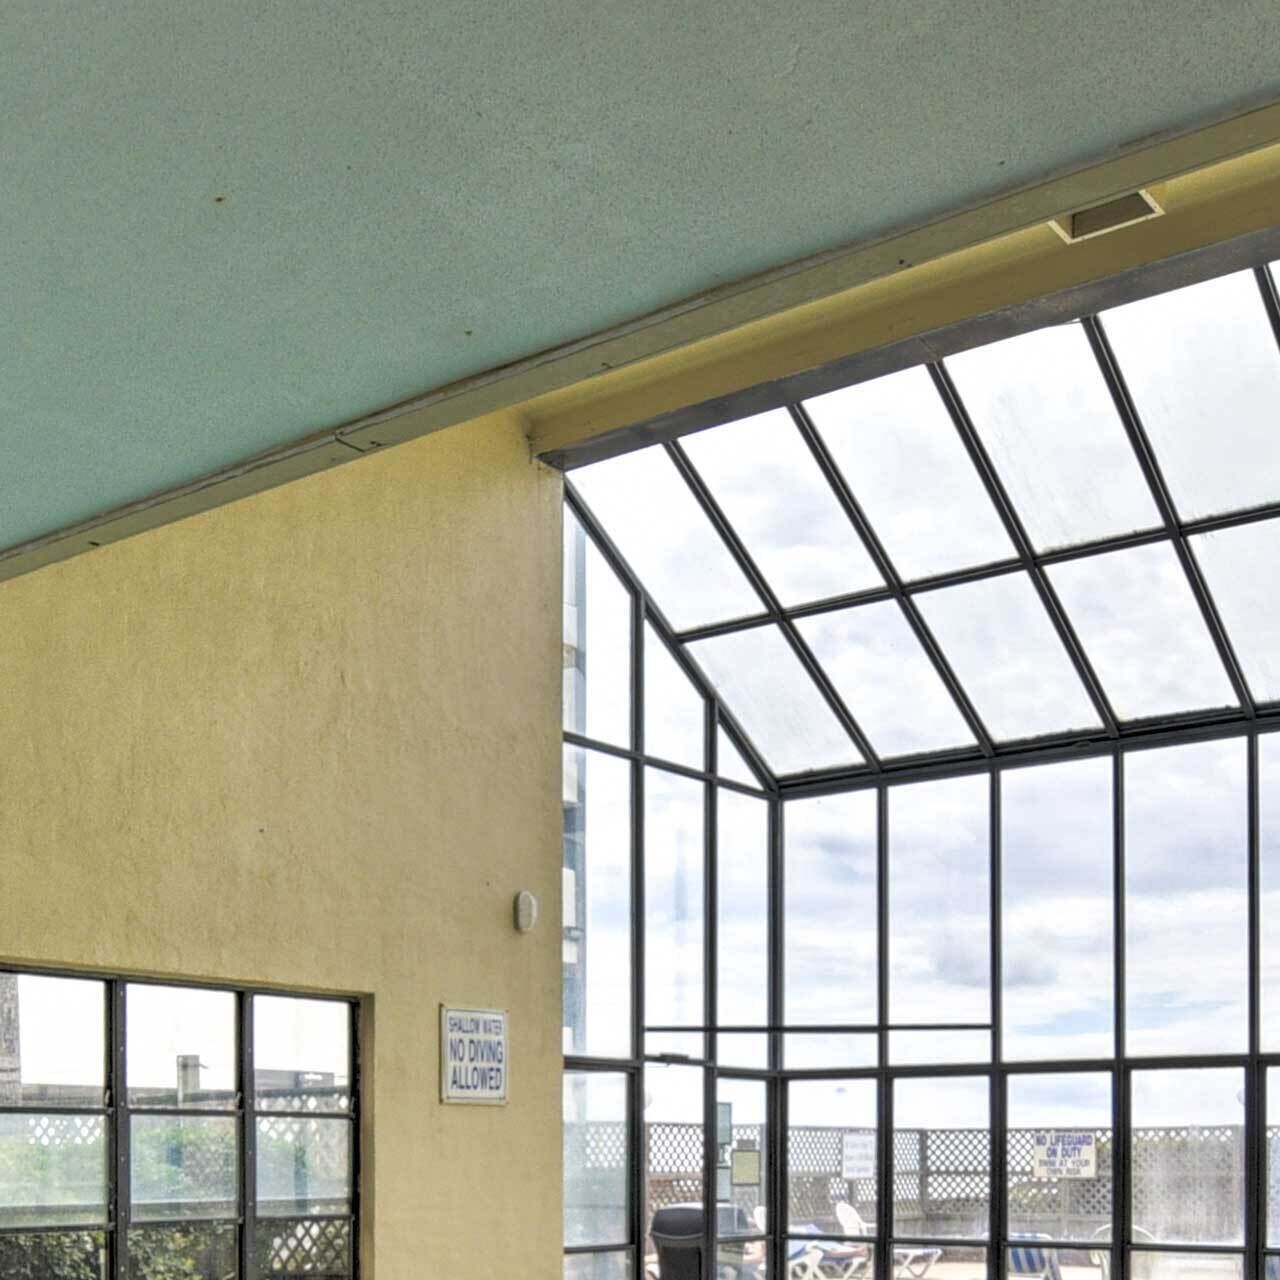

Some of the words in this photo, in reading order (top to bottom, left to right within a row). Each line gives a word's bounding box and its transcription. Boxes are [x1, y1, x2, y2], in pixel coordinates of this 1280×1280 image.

[449, 1038, 465, 1062] NO
[468, 1039, 503, 1064] DIVING
[450, 1066, 502, 1090] ALLOWED
[1035, 1135, 1047, 1146] NO
[1050, 1134, 1093, 1146] LIFEGUARD
[1046, 1147, 1058, 1158] ON
[1061, 1147, 1082, 1158] DUTY
